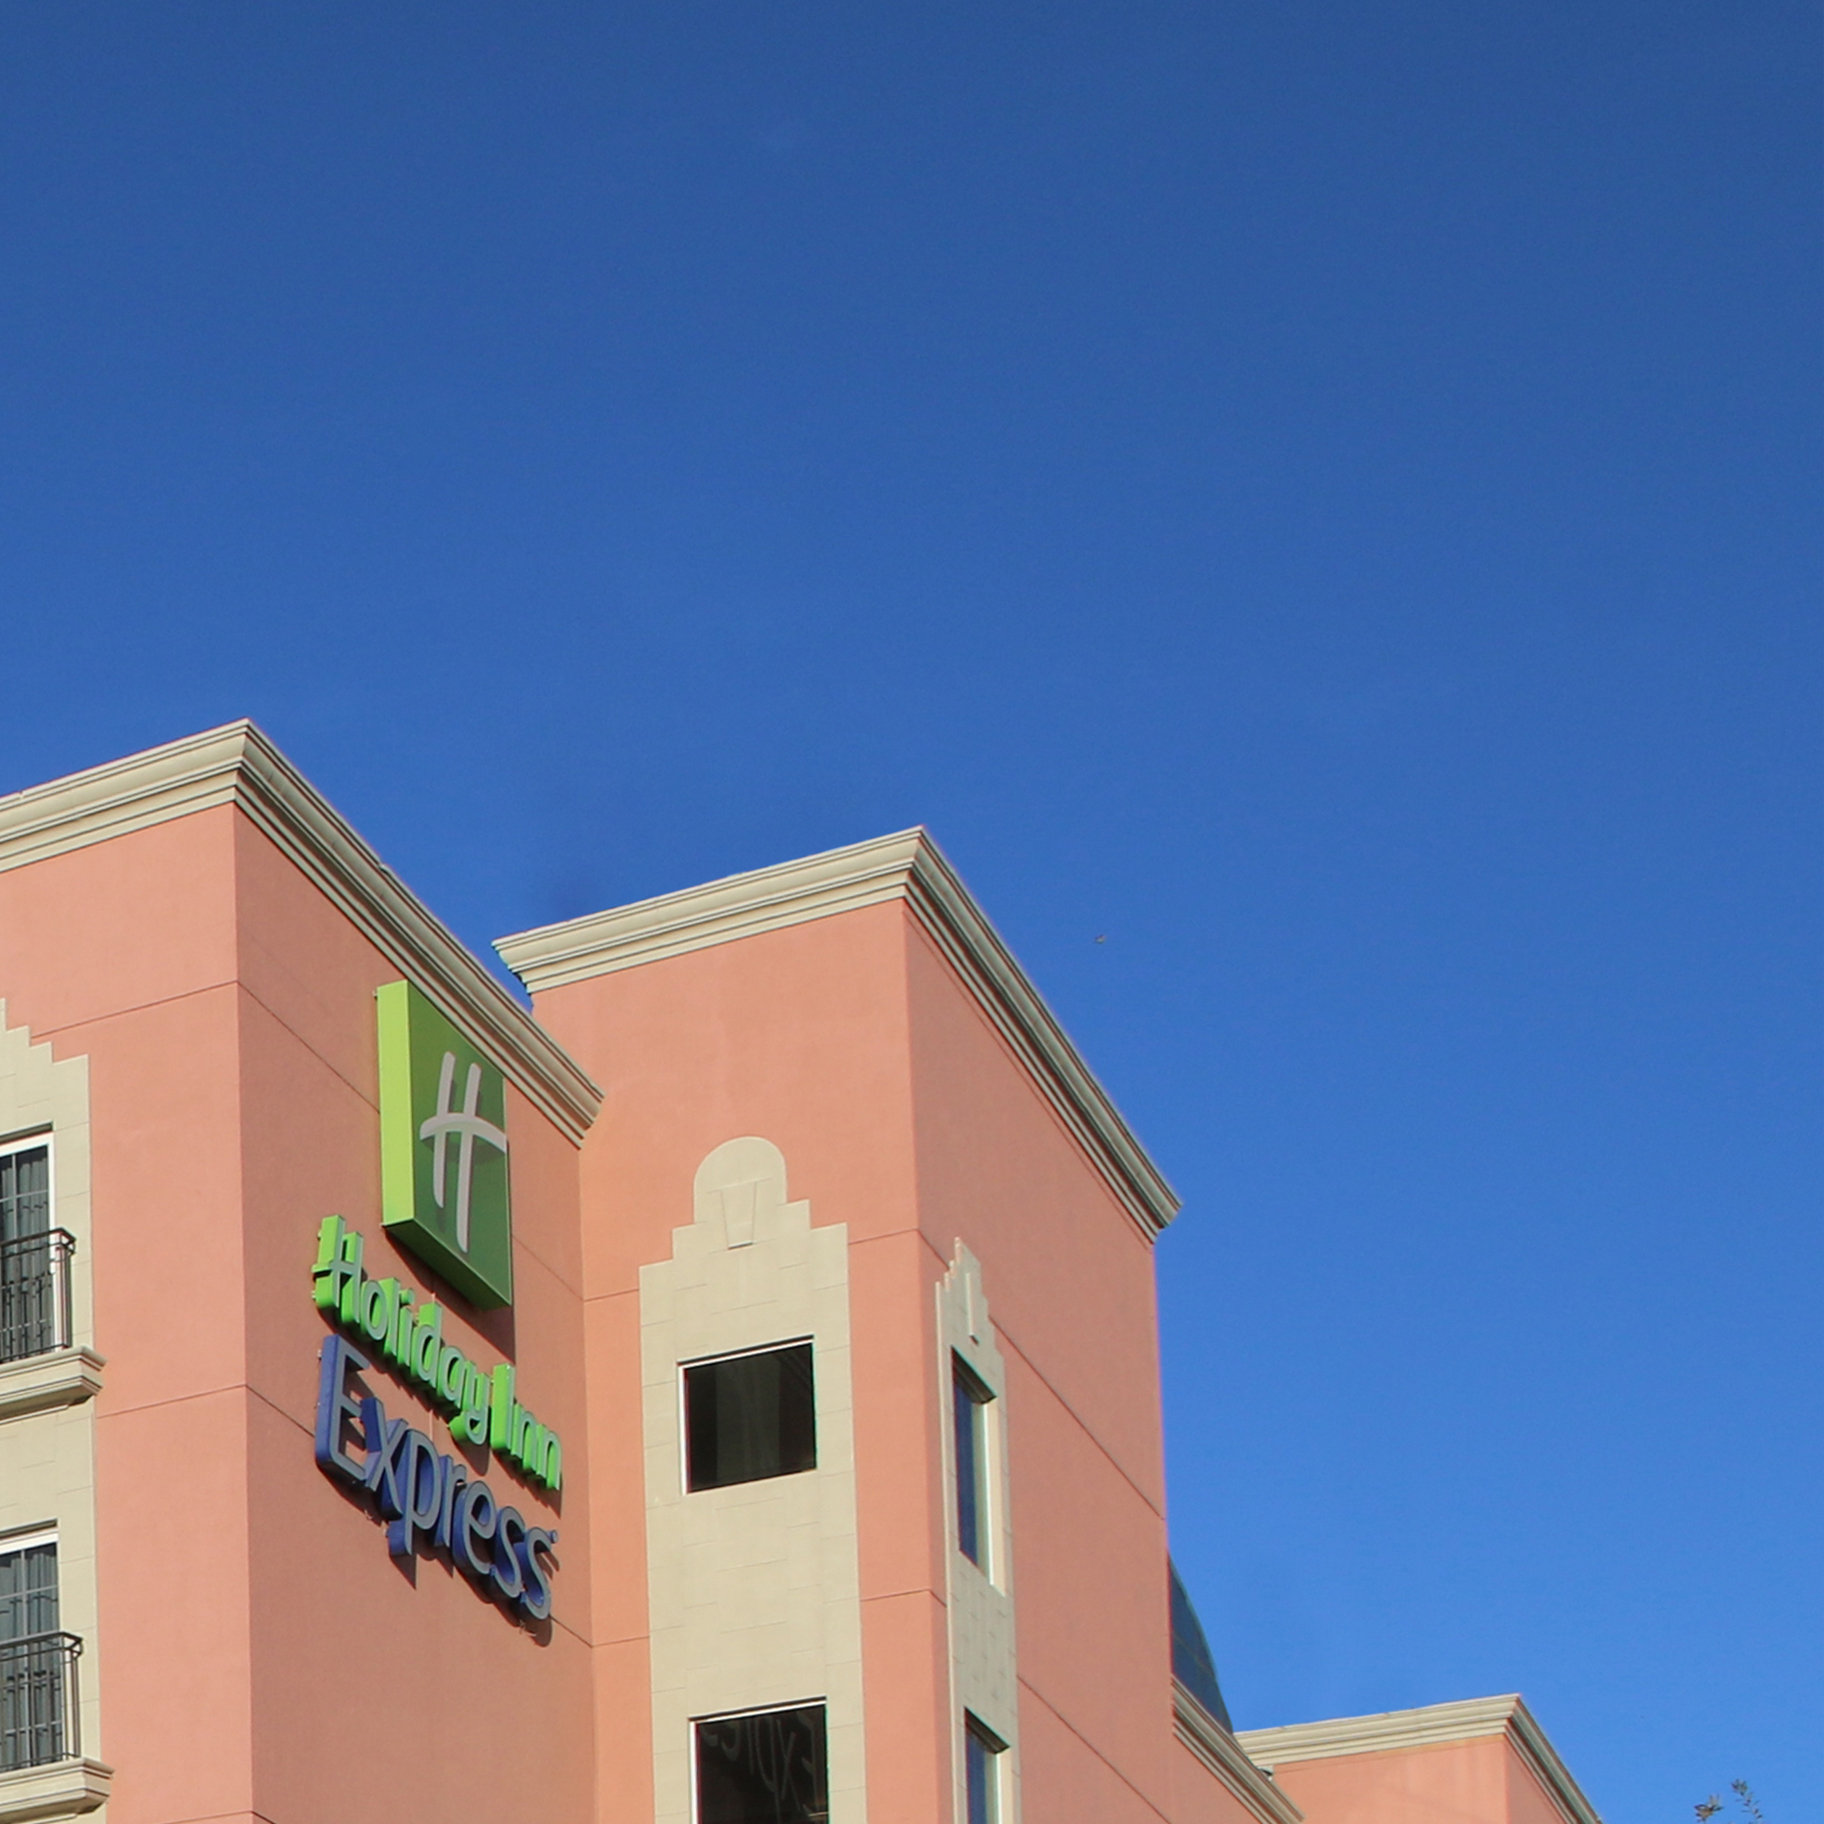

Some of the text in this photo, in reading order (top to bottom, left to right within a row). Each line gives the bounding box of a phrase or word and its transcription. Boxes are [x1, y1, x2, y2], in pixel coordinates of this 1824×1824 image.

[312, 1214, 561, 1490] Holiday Inn
[315, 1334, 552, 1621] Express
